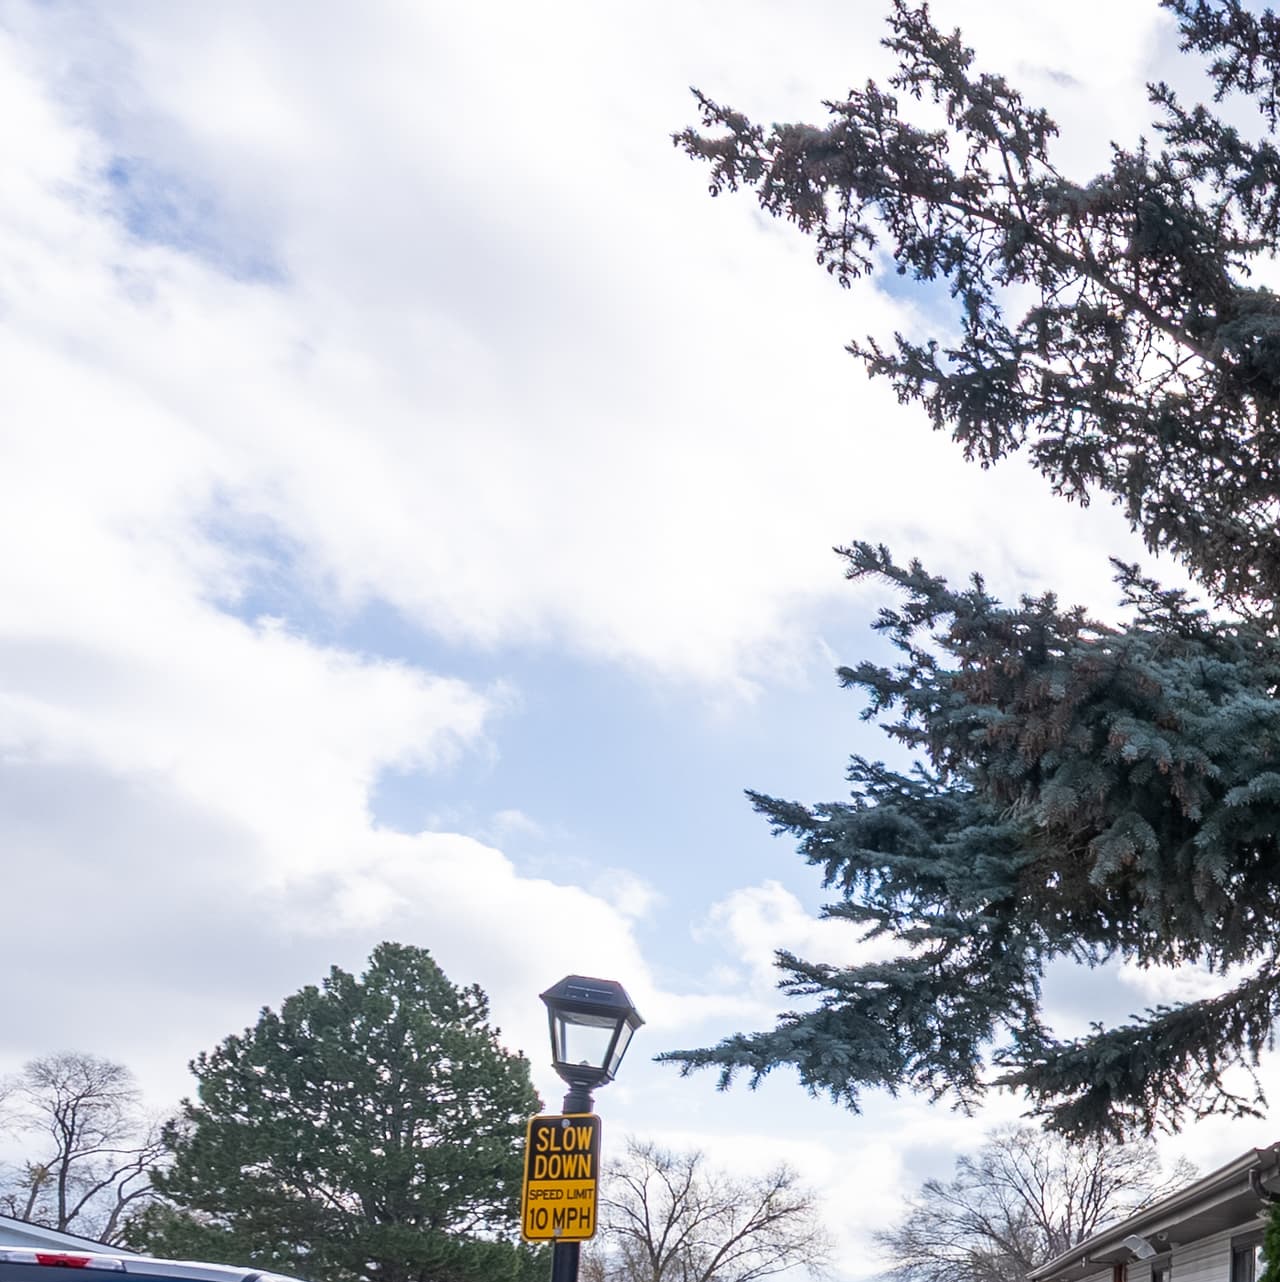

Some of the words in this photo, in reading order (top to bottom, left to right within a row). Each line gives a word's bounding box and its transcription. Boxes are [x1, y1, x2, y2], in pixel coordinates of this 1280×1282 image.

[536, 1126, 593, 1152] SLOW
[534, 1154, 592, 1179] DOWN
[529, 1189, 563, 1200] SPEED
[567, 1188, 594, 1200] LIMIT
[530, 1207, 549, 1230] 10
[553, 1207, 591, 1230] MPH
